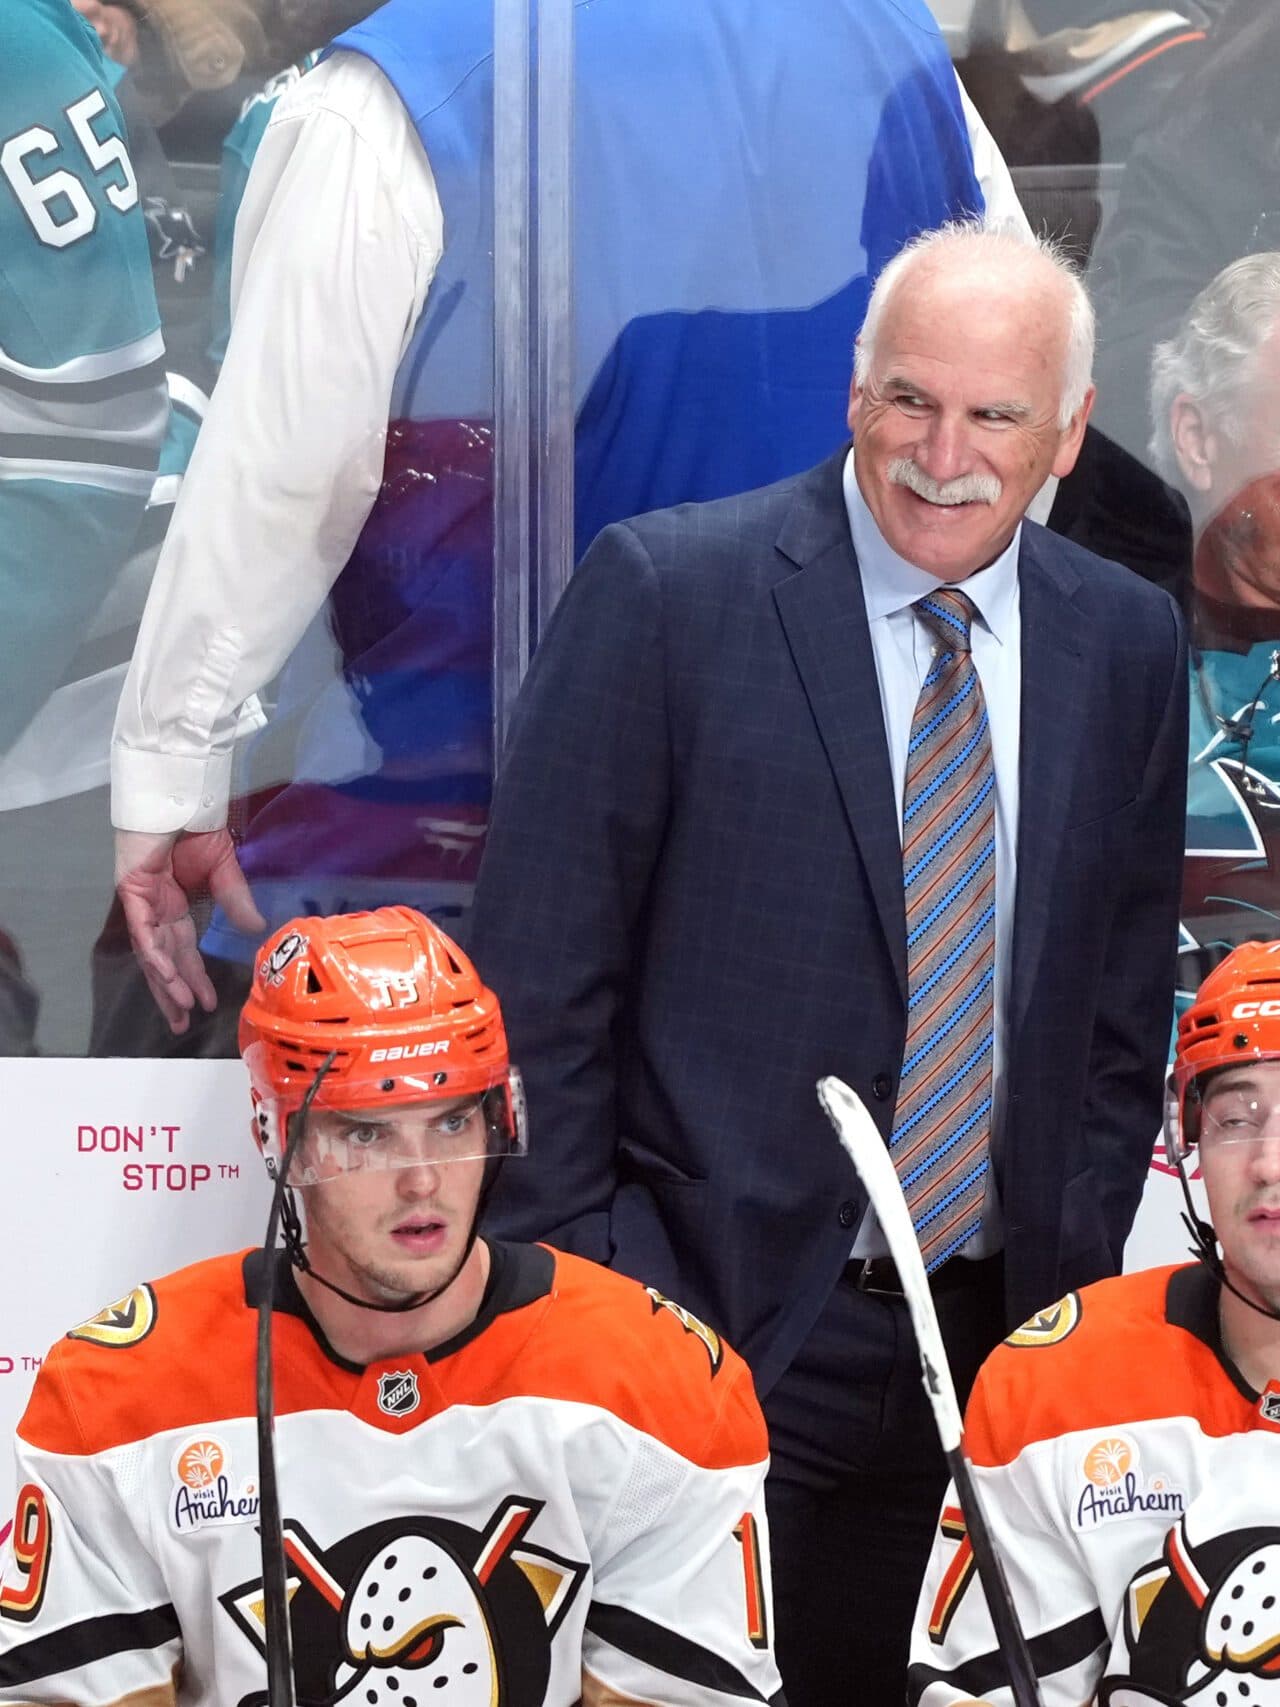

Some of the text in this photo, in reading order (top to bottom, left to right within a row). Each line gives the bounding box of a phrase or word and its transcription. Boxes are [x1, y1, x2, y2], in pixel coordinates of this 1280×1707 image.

[0, 84, 139, 248] 65
[369, 1040, 450, 1063] BAUER
[77, 1125, 181, 1153] DON'T
[386, 1381, 411, 1408] NHL
[175, 1475, 260, 1528] Anahei
[193, 1489, 215, 1499] visit
[1078, 1472, 1185, 1527] Anaheim
[1100, 1486, 1122, 1497] visit
